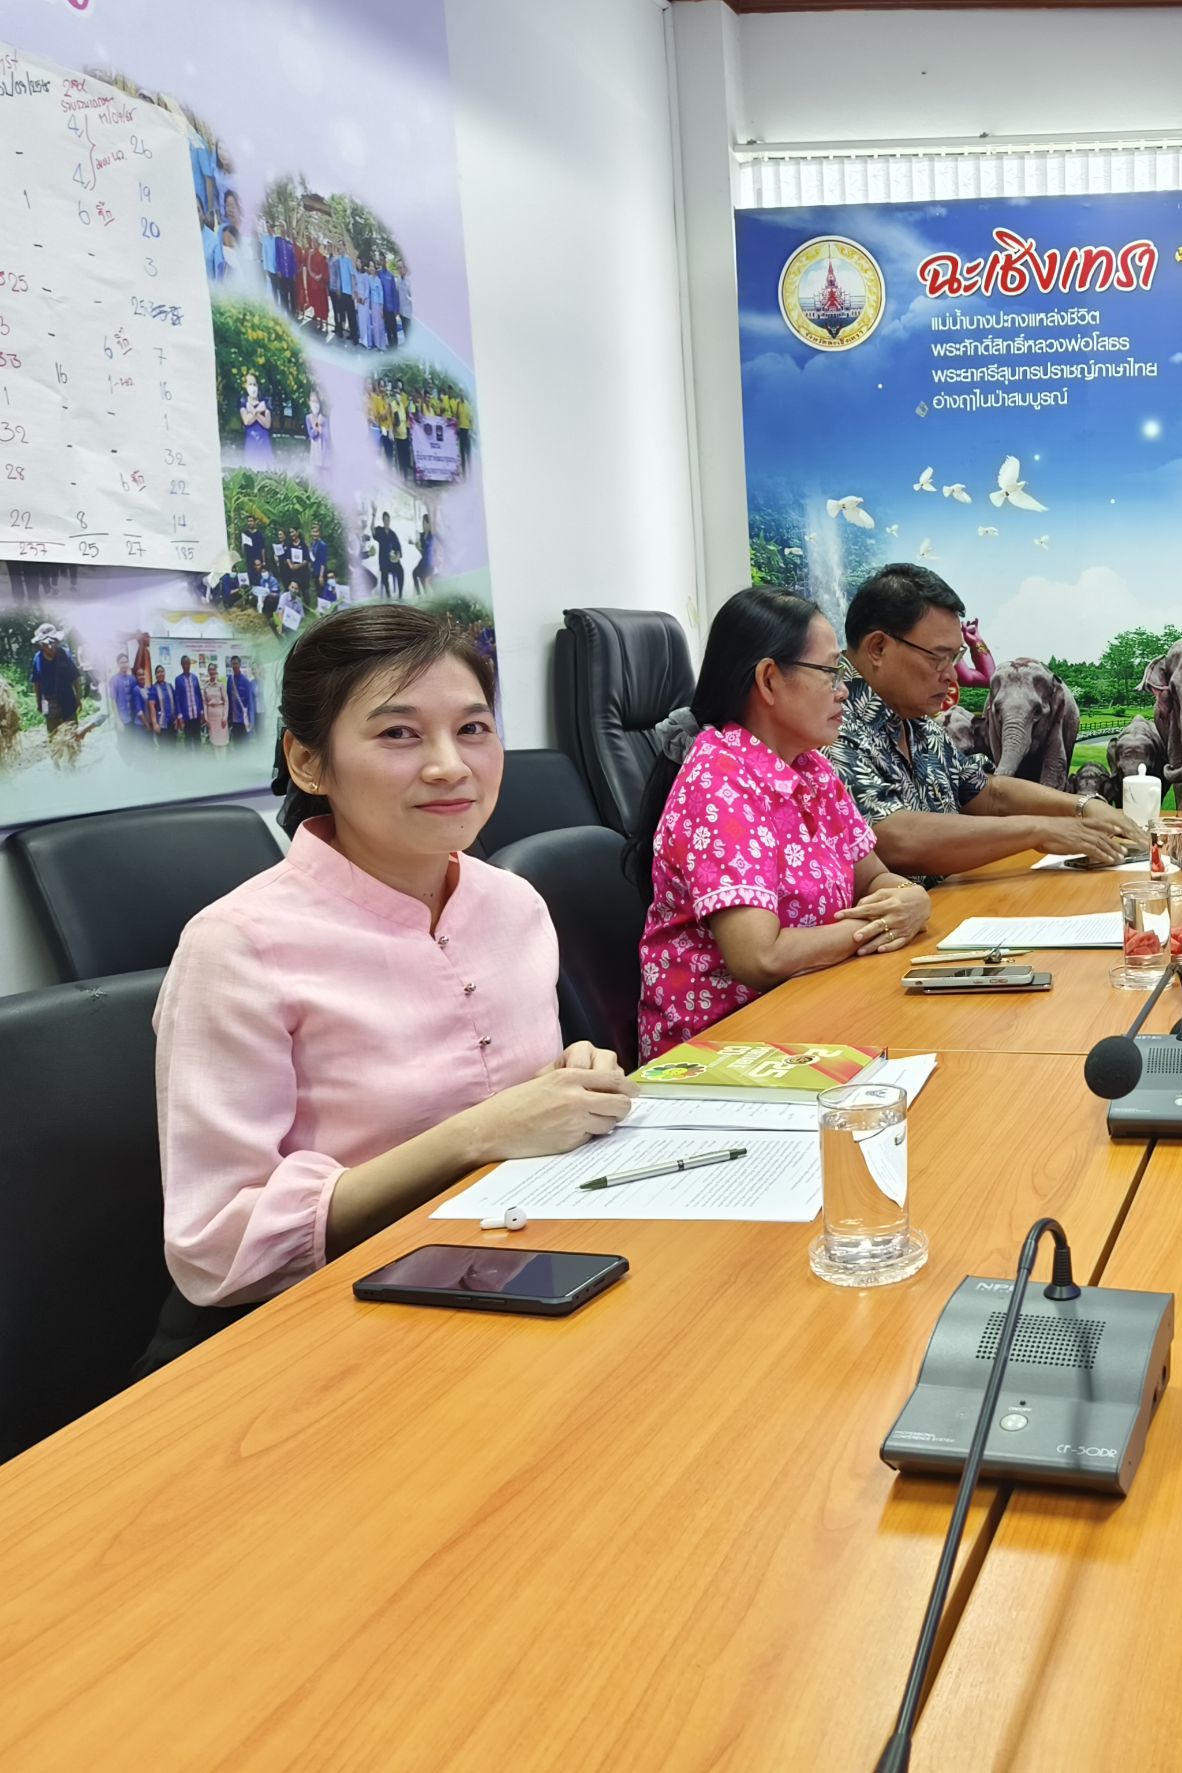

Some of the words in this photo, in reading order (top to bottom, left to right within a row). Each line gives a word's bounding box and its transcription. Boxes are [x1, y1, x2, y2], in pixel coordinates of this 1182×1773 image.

[138, 181, 151, 203] 19
[140, 216, 161, 239] 20
[144, 257, 158, 278] 3
[918, 227, 1159, 298] ฉะเชิงเทรา
[931, 308, 1101, 331] แม่น้ำบางปะกงแหล่งชีวิต
[931, 331, 1130, 357] พระศักดิ์สิทธิ์หลวงพ่อโสธร
[931, 358, 1158, 385] พระยาศรีสุนทรปราชญ์ภาษาไทย
[163, 447, 188, 467] 32
[5, 463, 26, 481] 28
[169, 479, 191, 496] 22
[10, 508, 34, 530] 22
[76, 510, 89, 530] 8
[172, 513, 188, 534] 14
[18, 542, 49, 556] 237
[78, 540, 101, 558] 25
[126, 540, 147, 556] 27
[175, 546, 196, 561] 185
